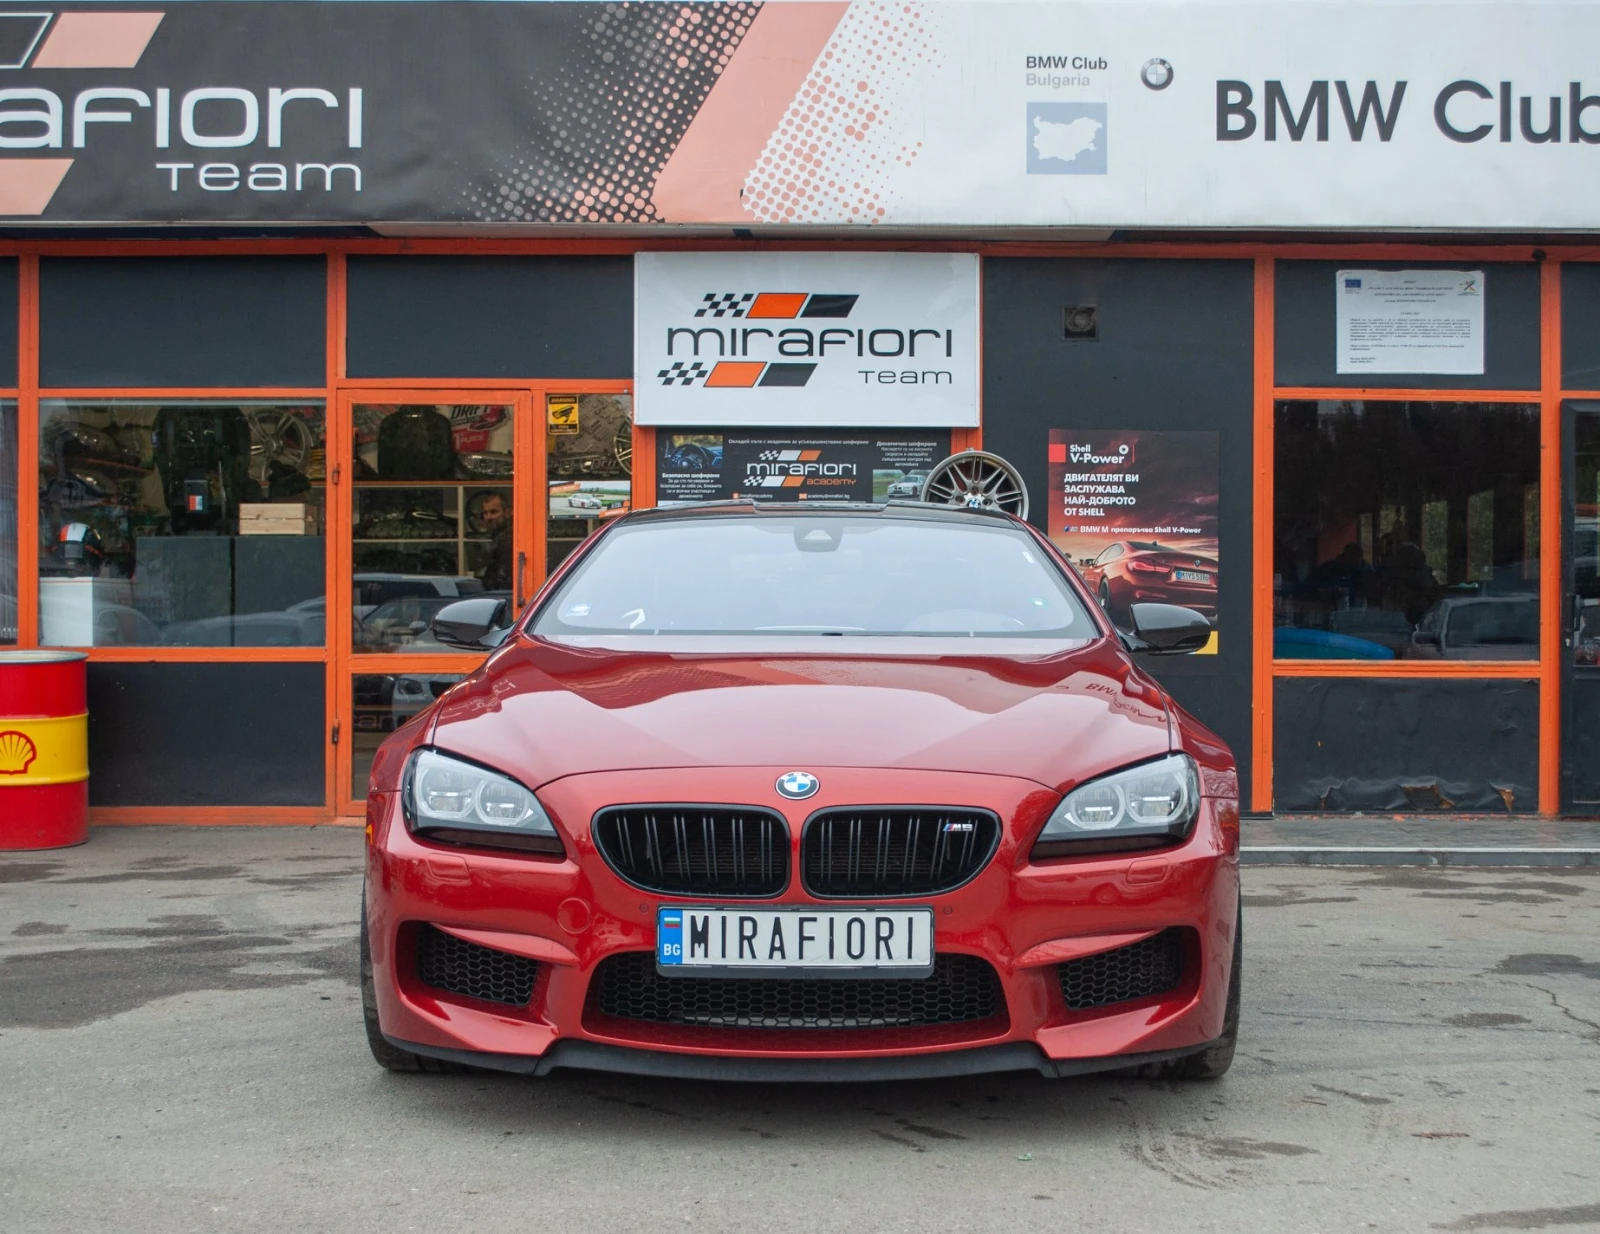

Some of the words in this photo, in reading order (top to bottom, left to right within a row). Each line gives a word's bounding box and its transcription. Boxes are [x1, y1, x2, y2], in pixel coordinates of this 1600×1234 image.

[1026, 56, 1068, 69] BMW
[1072, 57, 1108, 70] Club
[1026, 73, 1090, 88] Bulgaria
[1216, 80, 1408, 142] BMW
[1433, 80, 1600, 144] Club
[156, 163, 362, 191] Team
[667, 328, 952, 357] mirafiori
[858, 370, 952, 384] Team
[1070, 453, 1124, 464] V-Power
[747, 463, 856, 475] mirafiori
[1064, 474, 1123, 483] ДВИГАТЕЛЯТ
[1125, 474, 1139, 482] ВИ
[1064, 485, 1125, 494] ЗАСЛУЖАВА
[1064, 495, 1136, 506] НАЙ-ДОБРОТО
[1079, 508, 1105, 516] SHELL
[690, 916, 913, 960] MIRAFIORI
[664, 943, 680, 956] BG
